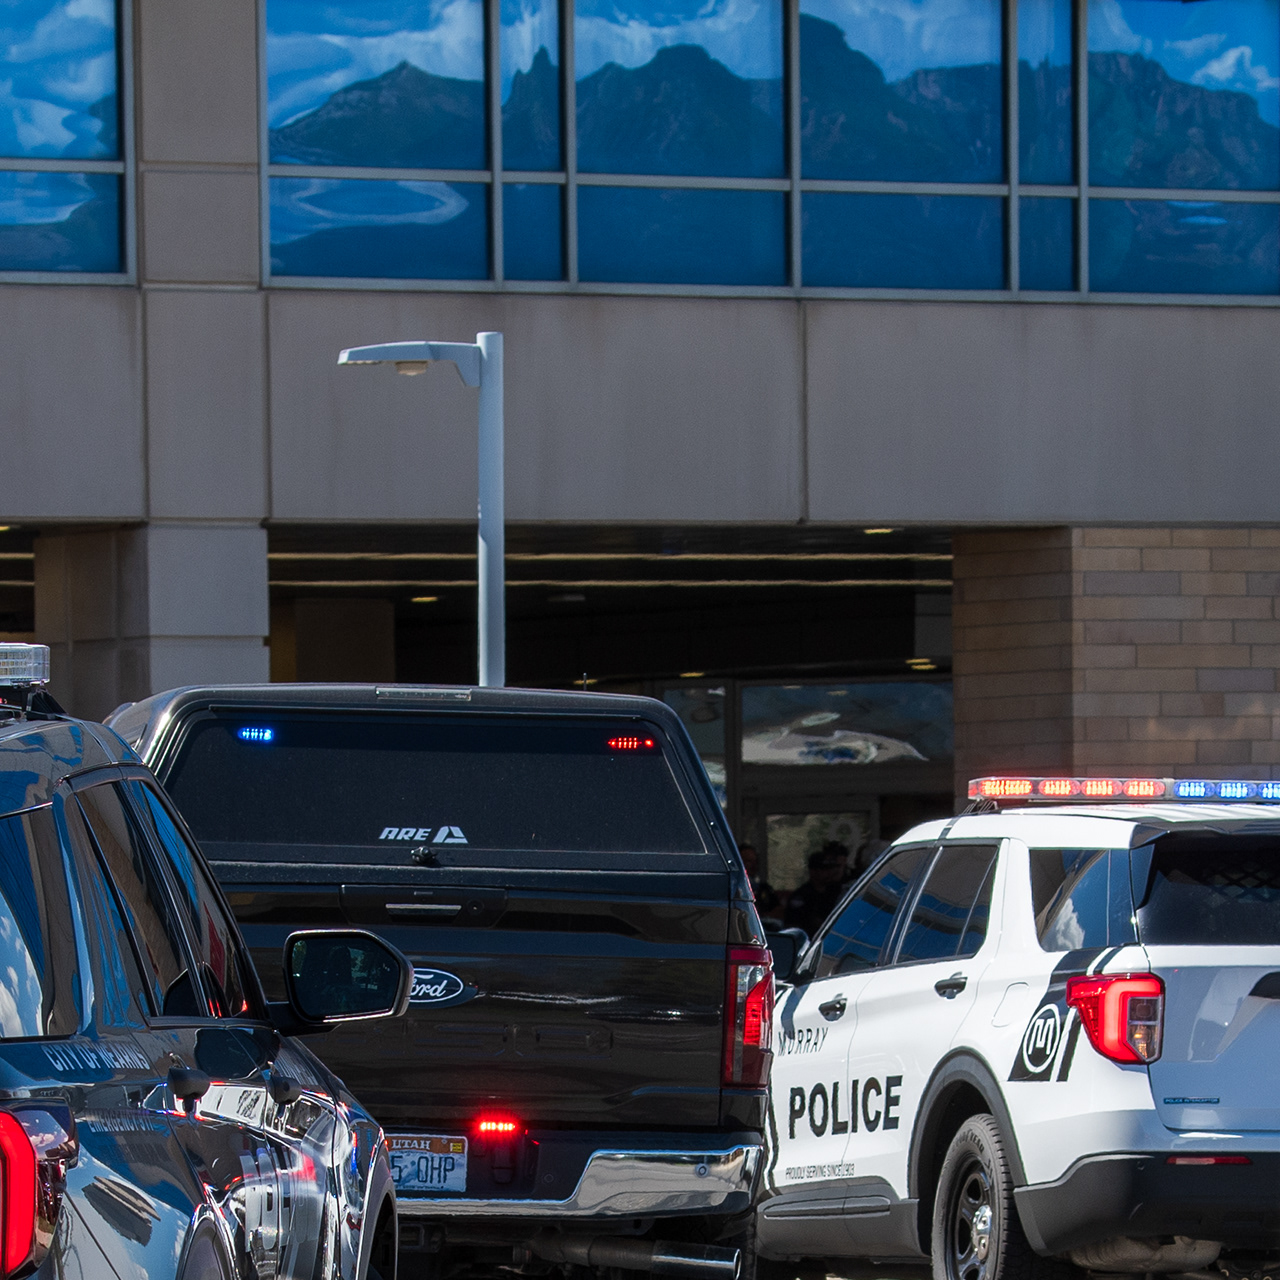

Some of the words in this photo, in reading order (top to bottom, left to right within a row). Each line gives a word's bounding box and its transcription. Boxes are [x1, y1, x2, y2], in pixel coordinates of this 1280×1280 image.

[378, 827, 432, 841] ARE
[40, 1042, 84, 1072] CITY
[777, 1027, 829, 1057] MURRAY
[788, 1074, 904, 1140] POLICE
[391, 1139, 431, 1151] UTAH
